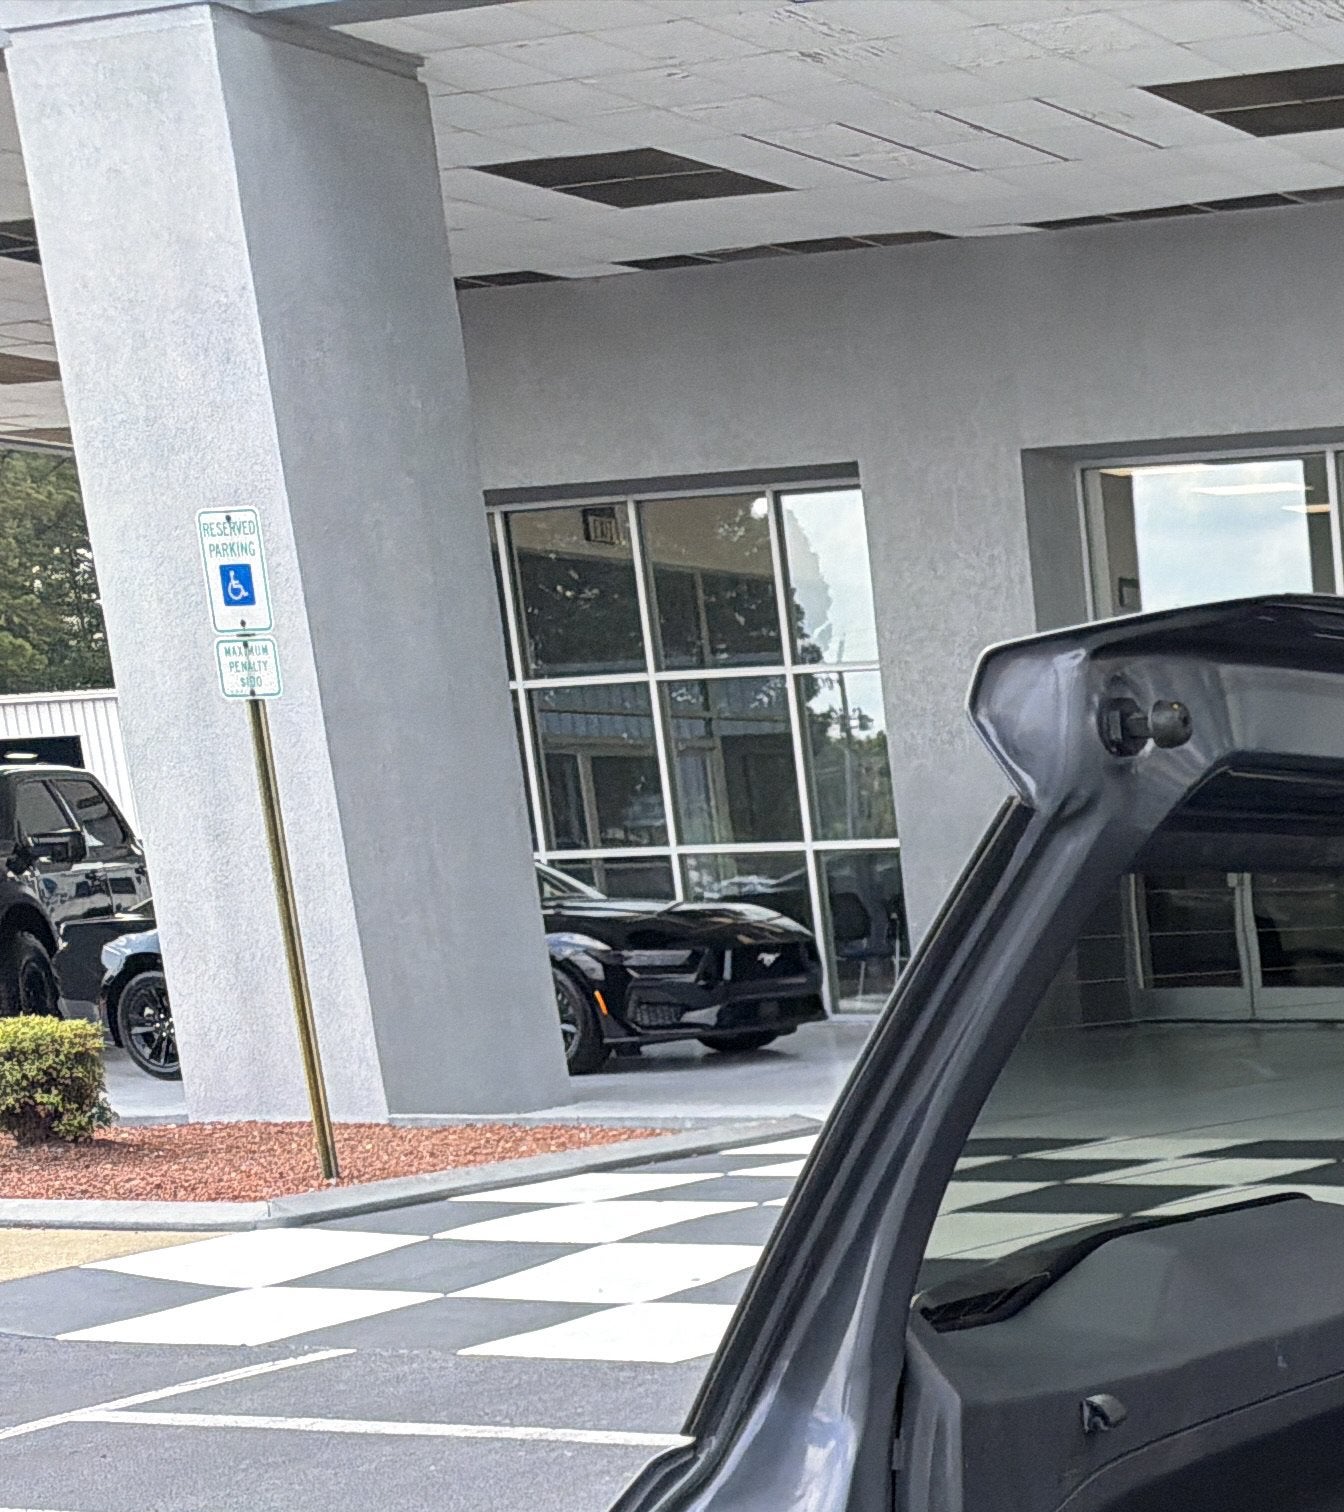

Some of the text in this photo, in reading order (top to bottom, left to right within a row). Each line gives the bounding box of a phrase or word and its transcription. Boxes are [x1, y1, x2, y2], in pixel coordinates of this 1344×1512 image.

[202, 520, 256, 537] RESERVED
[209, 541, 256, 558] PARKING
[229, 660, 268, 673] PENALTY
